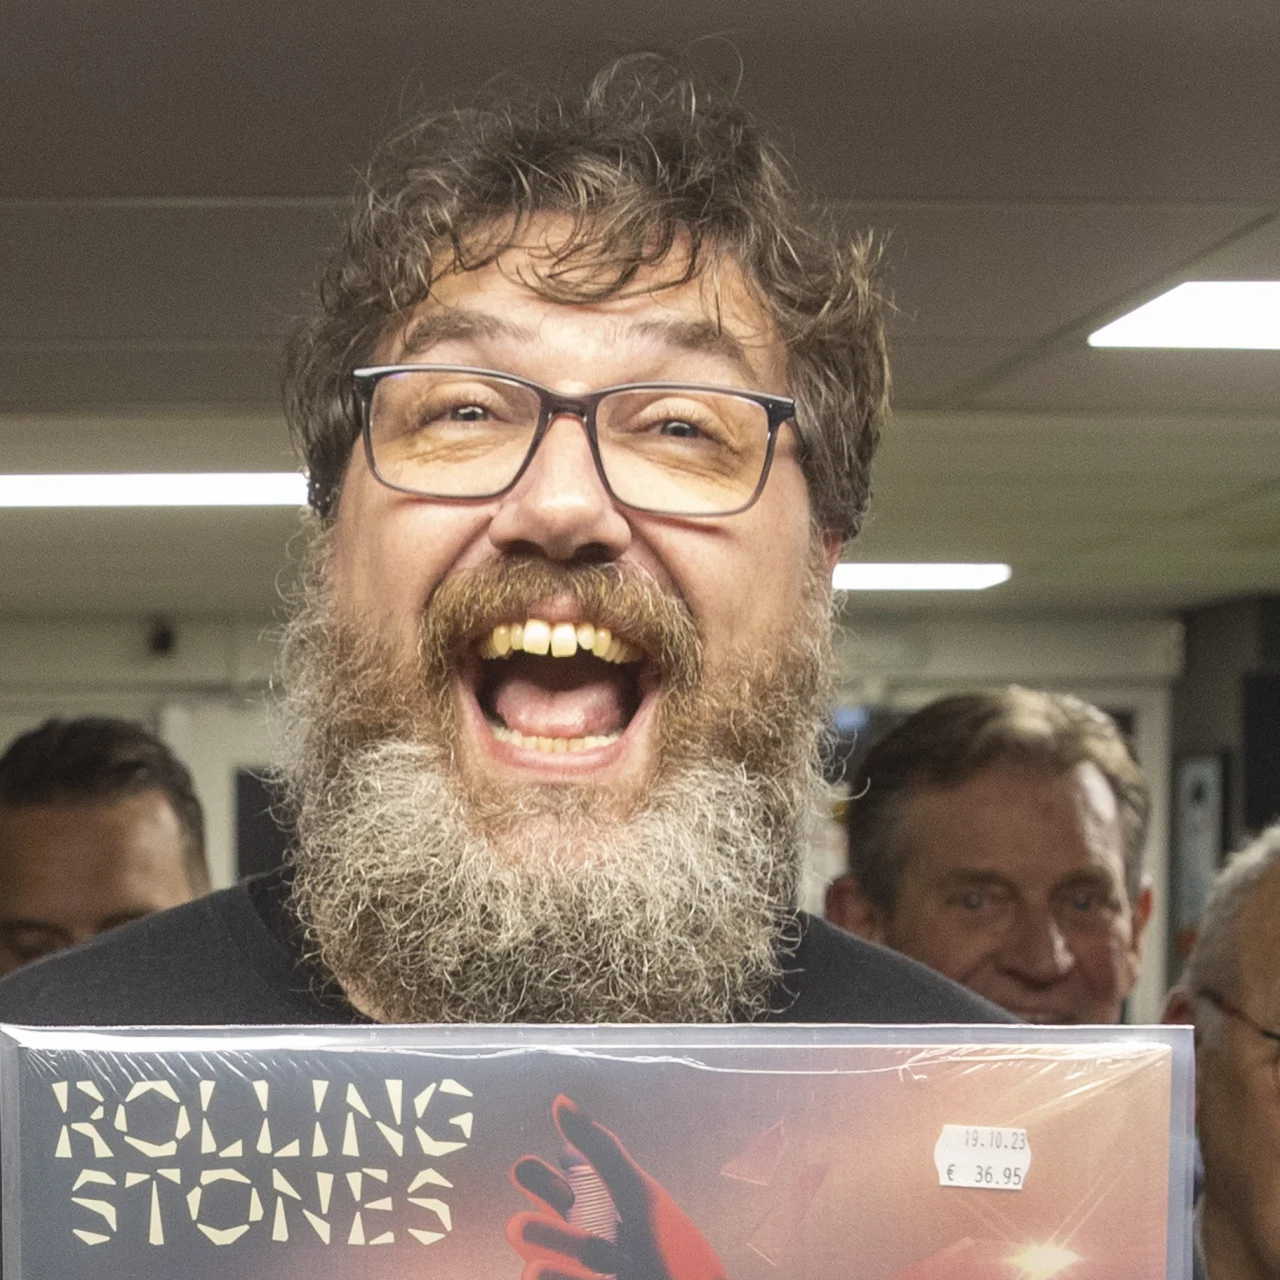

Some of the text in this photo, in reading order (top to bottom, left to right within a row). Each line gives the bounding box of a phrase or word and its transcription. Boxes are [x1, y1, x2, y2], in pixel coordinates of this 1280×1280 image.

[52, 1079, 473, 1158] ROLLING
[964, 1129, 1026, 1150] 19.10.23
[946, 1163, 1021, 1186] € 36.95
[72, 1168, 454, 1246] STONES
